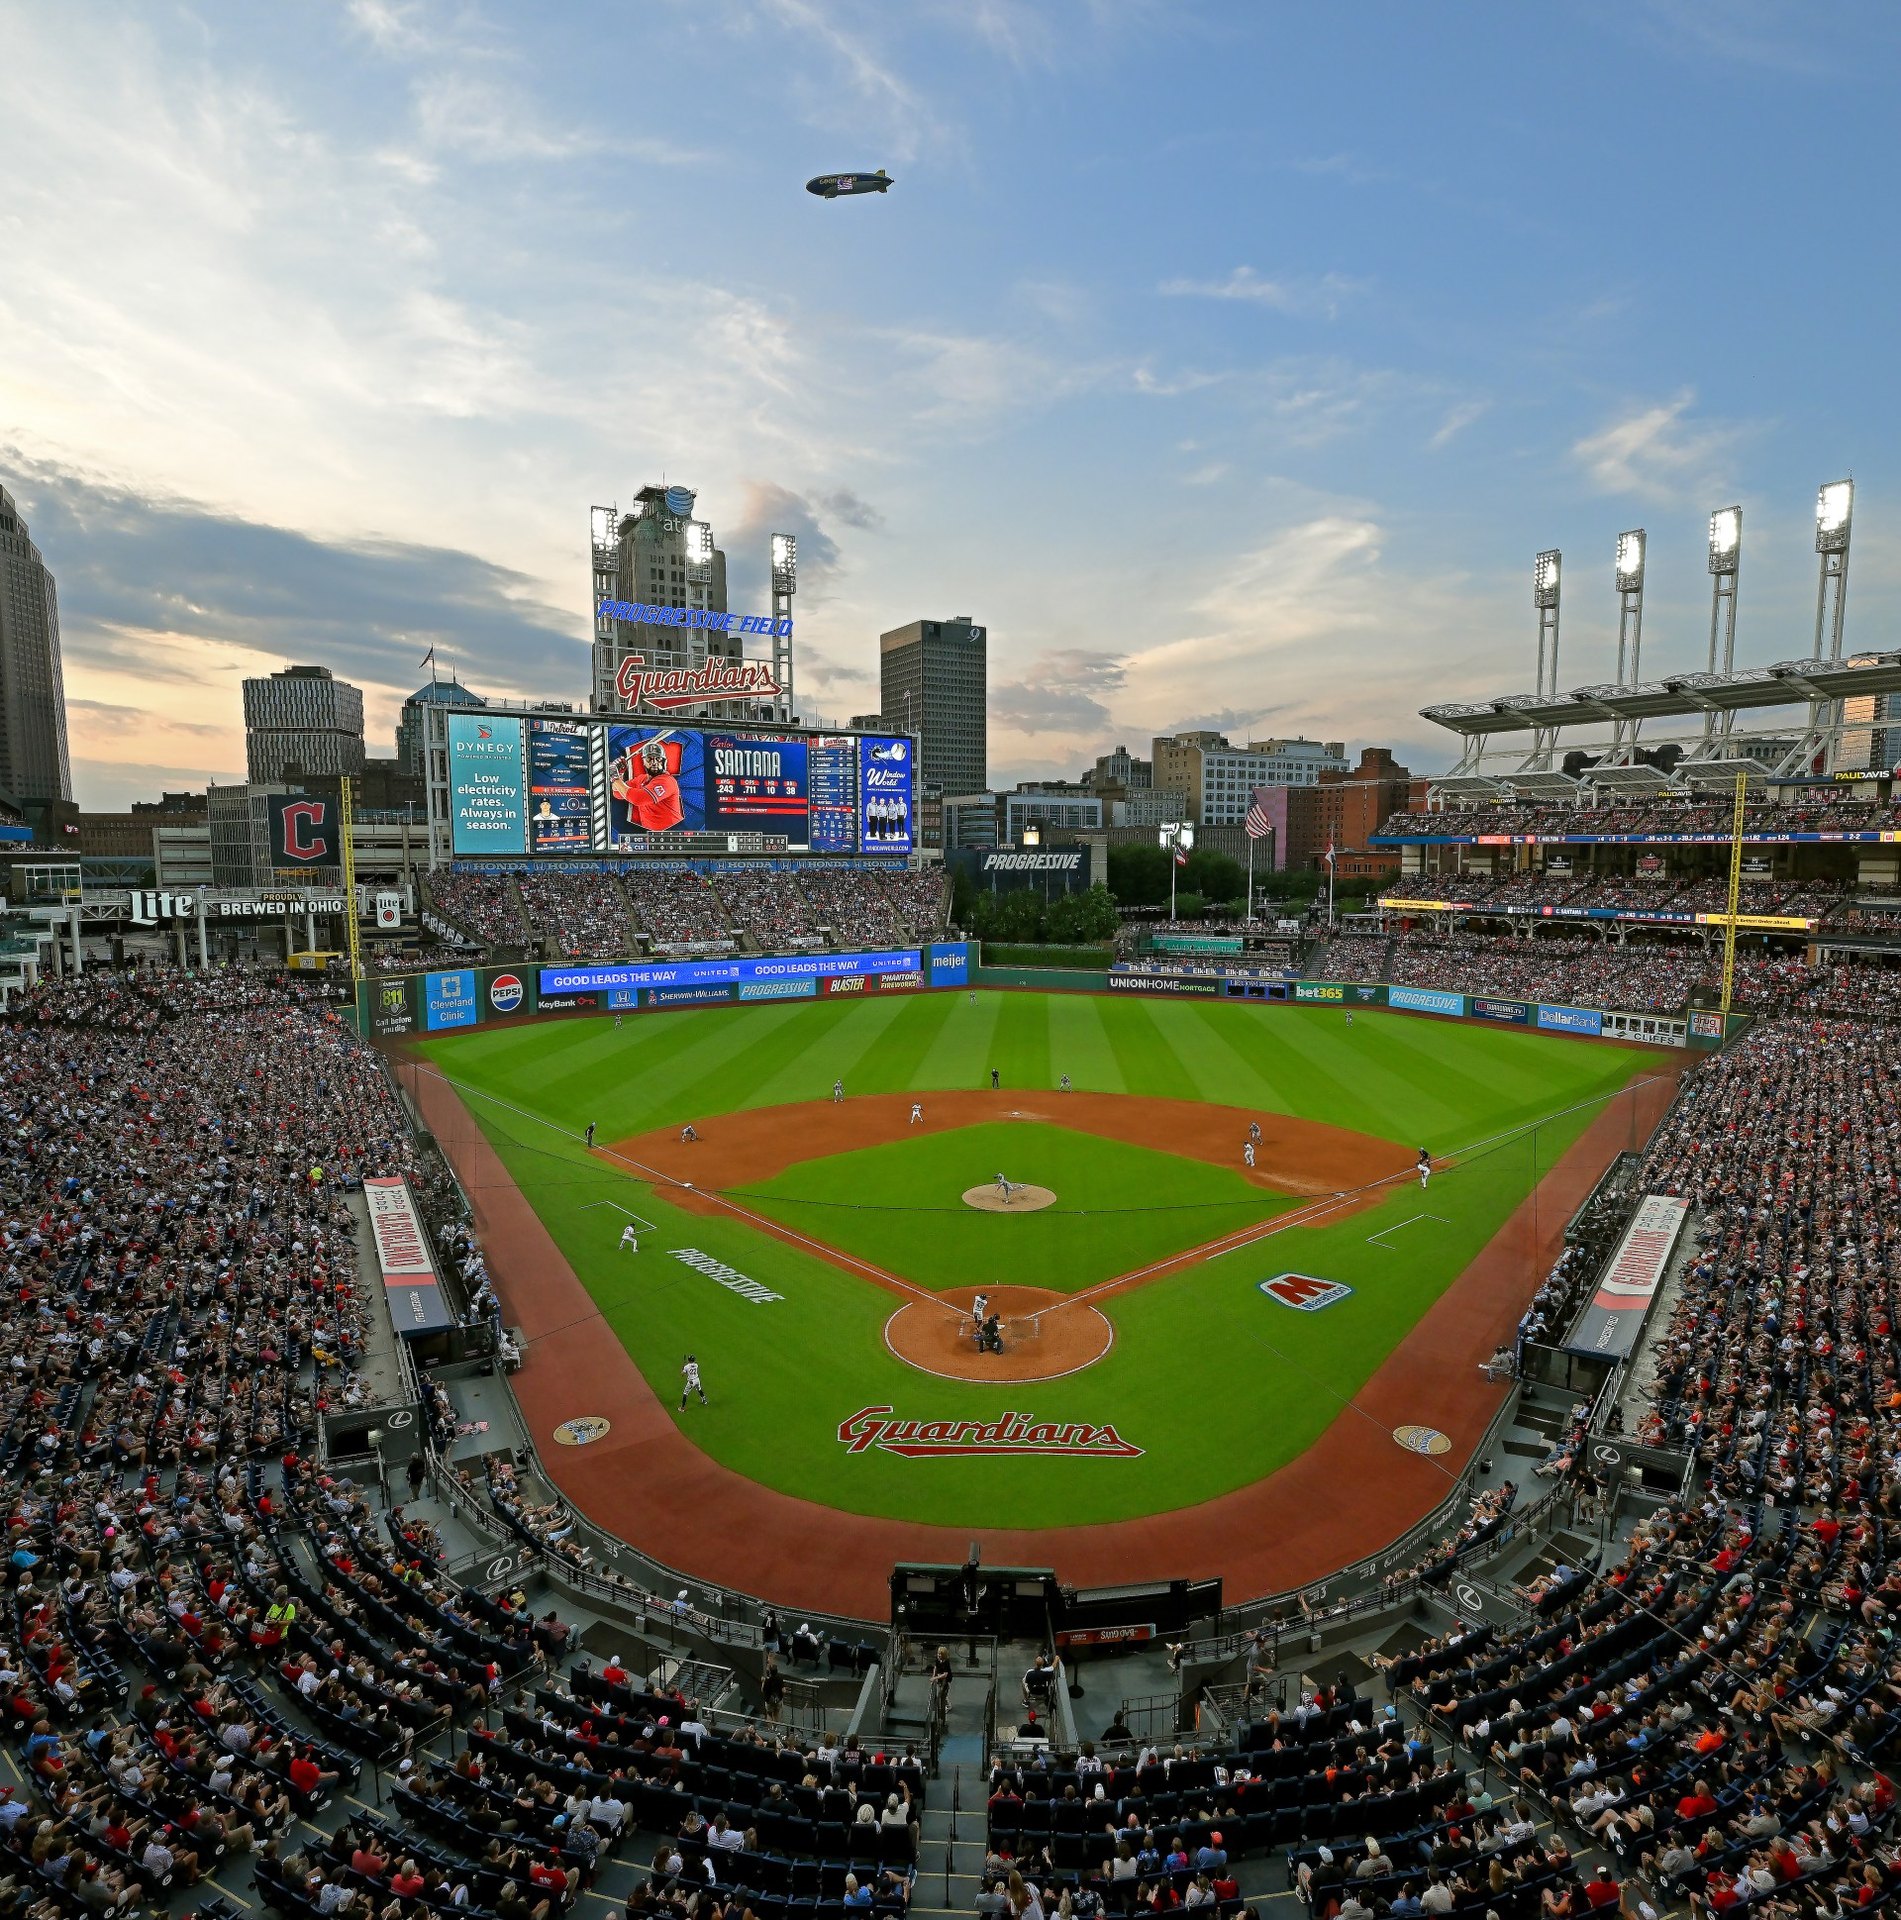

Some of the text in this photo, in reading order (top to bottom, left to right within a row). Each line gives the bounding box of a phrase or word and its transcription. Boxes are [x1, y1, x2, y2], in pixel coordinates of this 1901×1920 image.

[597, 599, 794, 638] PROGRESSIVE FIELD
[616, 655, 784, 711] Guardians
[456, 742, 514, 754] DYNEGY
[714, 748, 781, 777] SANTANA
[474, 772, 500, 784] Low
[457, 784, 517, 798] electricity
[717, 784, 734, 793] .243
[743, 785, 756, 794] .711
[767, 786, 776, 794] 10
[786, 786, 796, 795] 38
[471, 797, 505, 807] rates.
[459, 807, 517, 821] Always in
[281, 801, 327, 861] C
[466, 821, 512, 831] season.
[474, 862, 528, 870] HONDA
[550, 862, 601, 870] HONDA
[641, 860, 689, 869] HONDA
[727, 861, 773, 869] HONDA
[808, 861, 850, 869] HONDA
[862, 860, 902, 869] HONDA
[983, 854, 1082, 870] PROGRESSIVE
[262, 893, 303, 902] PROUDLY
[128, 889, 195, 926] Lite
[220, 900, 342, 917] BREWED IN OHIO
[932, 954, 966, 969] meijer
[693, 969, 729, 977] UNITED
[755, 961, 859, 975] GOOD LEADS THE WAY
[554, 970, 678, 987] GOOD LEADS THE WAY
[880, 972, 918, 983] PHANTOM
[741, 982, 811, 996] PROGRESSIVE
[830, 978, 864, 992] BLASTER
[880, 981, 915, 990] FIREWORKS
[382, 988, 404, 1007] 811
[491, 987, 521, 999] PEPSI
[1295, 986, 1343, 999] bet365
[430, 997, 473, 1011] Cleveland
[538, 999, 577, 1010] KeyBank
[1391, 991, 1457, 1010] PROGRESSIVE
[439, 1011, 466, 1022] Clinic
[1693, 1016, 1717, 1028] drug
[1694, 1026, 1721, 1035] mart
[1633, 1032, 1675, 1046] CLIFFS
[837, 1405, 1147, 1459] Guardians
